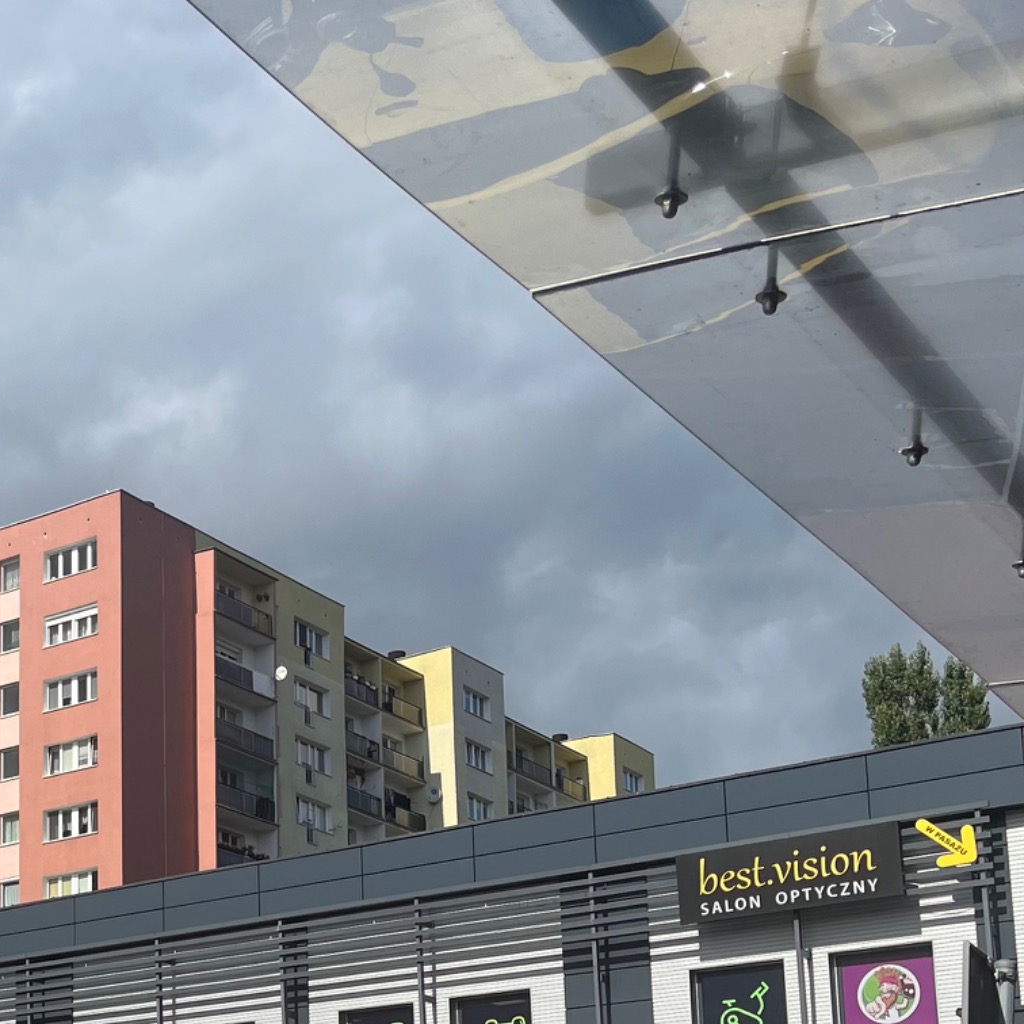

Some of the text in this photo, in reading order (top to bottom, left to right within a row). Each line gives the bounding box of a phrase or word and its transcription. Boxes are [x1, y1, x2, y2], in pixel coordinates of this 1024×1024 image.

[699, 845, 877, 896] best.vision
[700, 878, 878, 916] SALON OPTYCZNY
